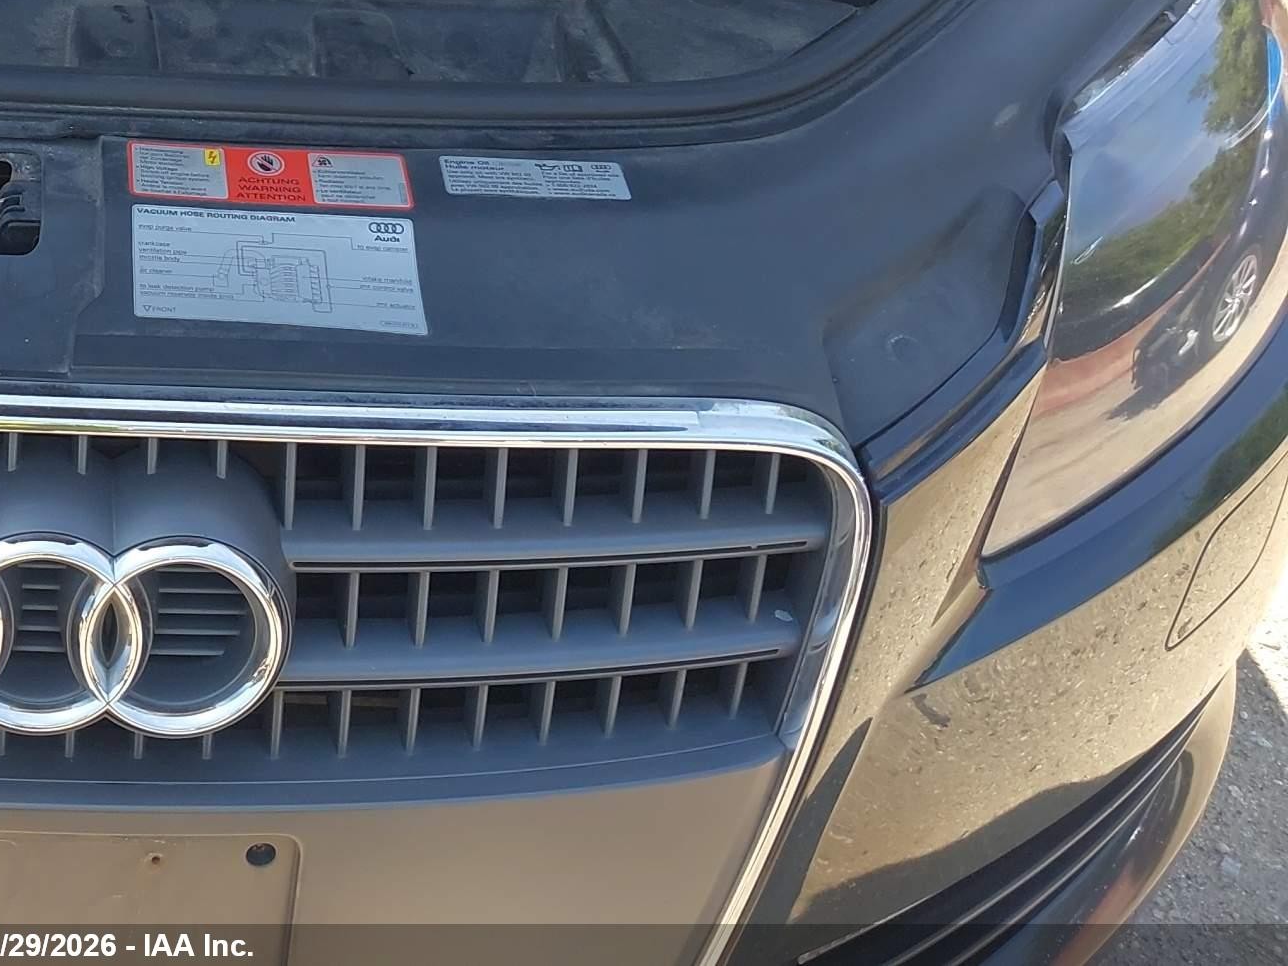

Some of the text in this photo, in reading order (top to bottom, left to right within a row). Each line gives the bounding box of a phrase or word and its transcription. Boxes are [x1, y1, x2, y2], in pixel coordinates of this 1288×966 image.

[237, 193, 306, 201] ATTENTION
[137, 208, 178, 216] VACUUM
[250, 214, 296, 222] DIAGRAM
